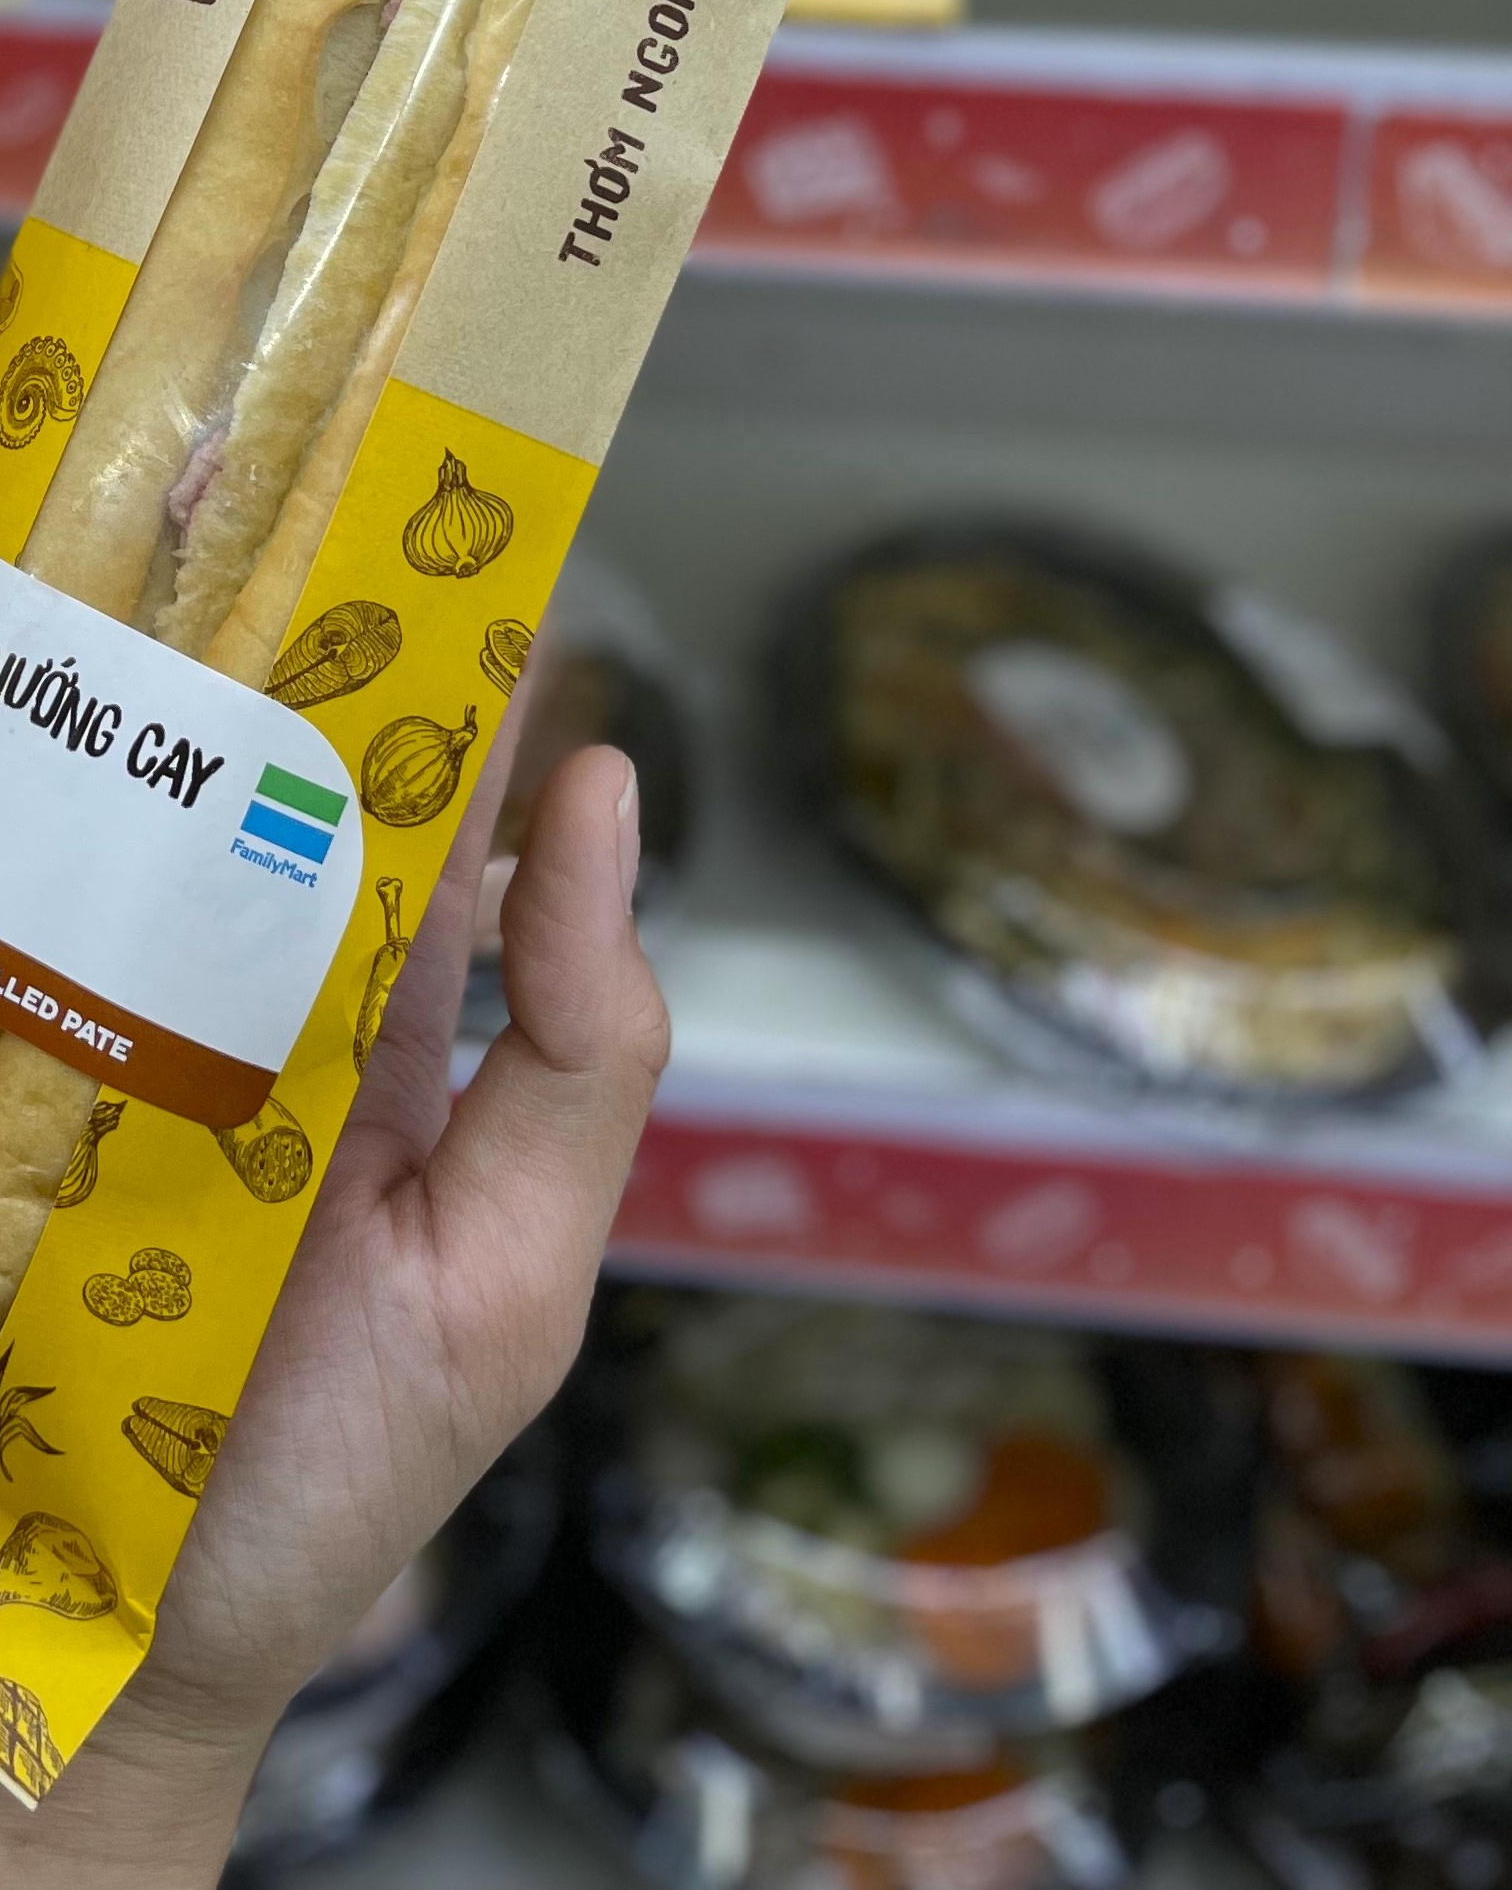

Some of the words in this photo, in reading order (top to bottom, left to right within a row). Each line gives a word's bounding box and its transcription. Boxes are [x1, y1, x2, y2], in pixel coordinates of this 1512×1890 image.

[558, 127, 645, 267] THƠM
[126, 722, 225, 808] CAY
[229, 838, 317, 888] FamilyMart
[61, 1007, 133, 1063] PATE
